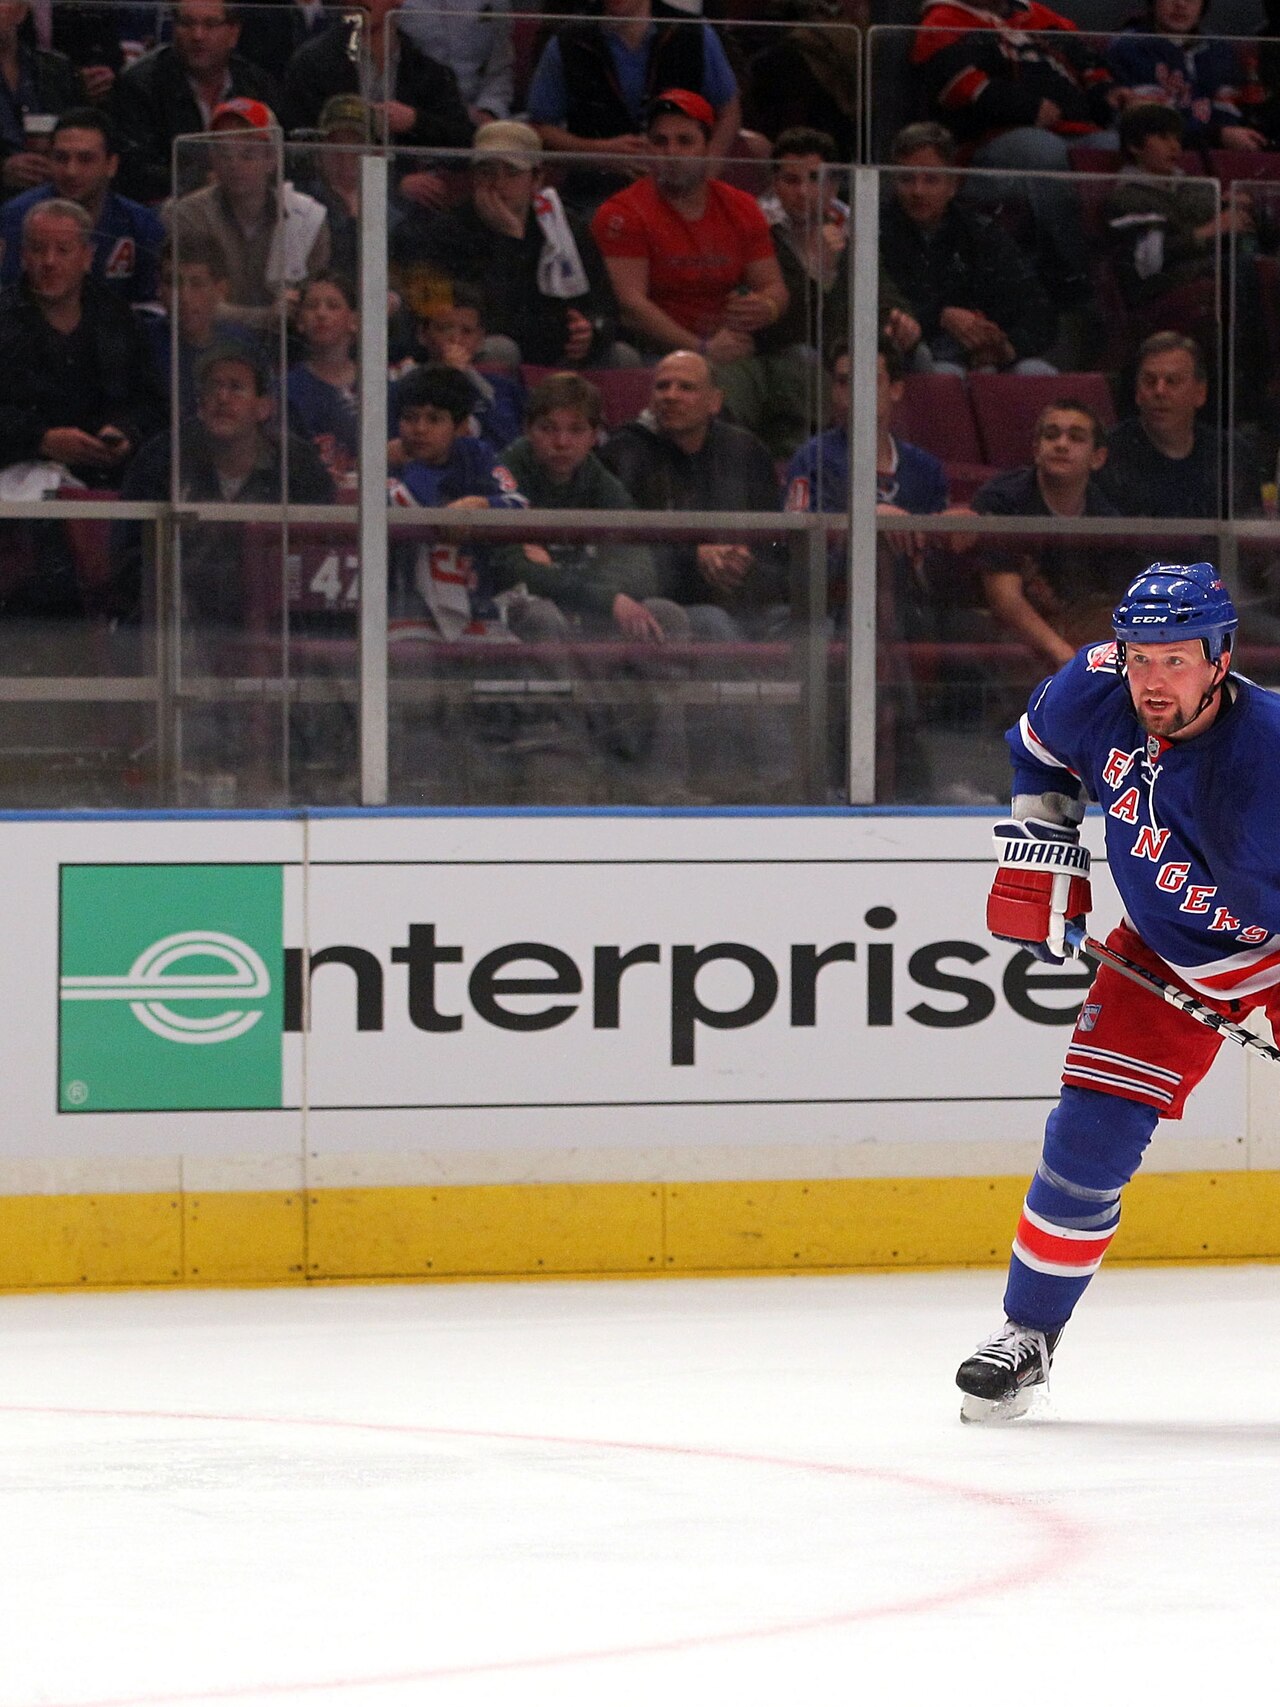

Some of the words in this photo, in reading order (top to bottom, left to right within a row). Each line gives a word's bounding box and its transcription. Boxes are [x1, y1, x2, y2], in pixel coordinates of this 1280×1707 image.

[1131, 616, 1168, 624] CCM
[1103, 747, 1269, 944] RANGERS
[61, 906, 1095, 1067] enterprise
